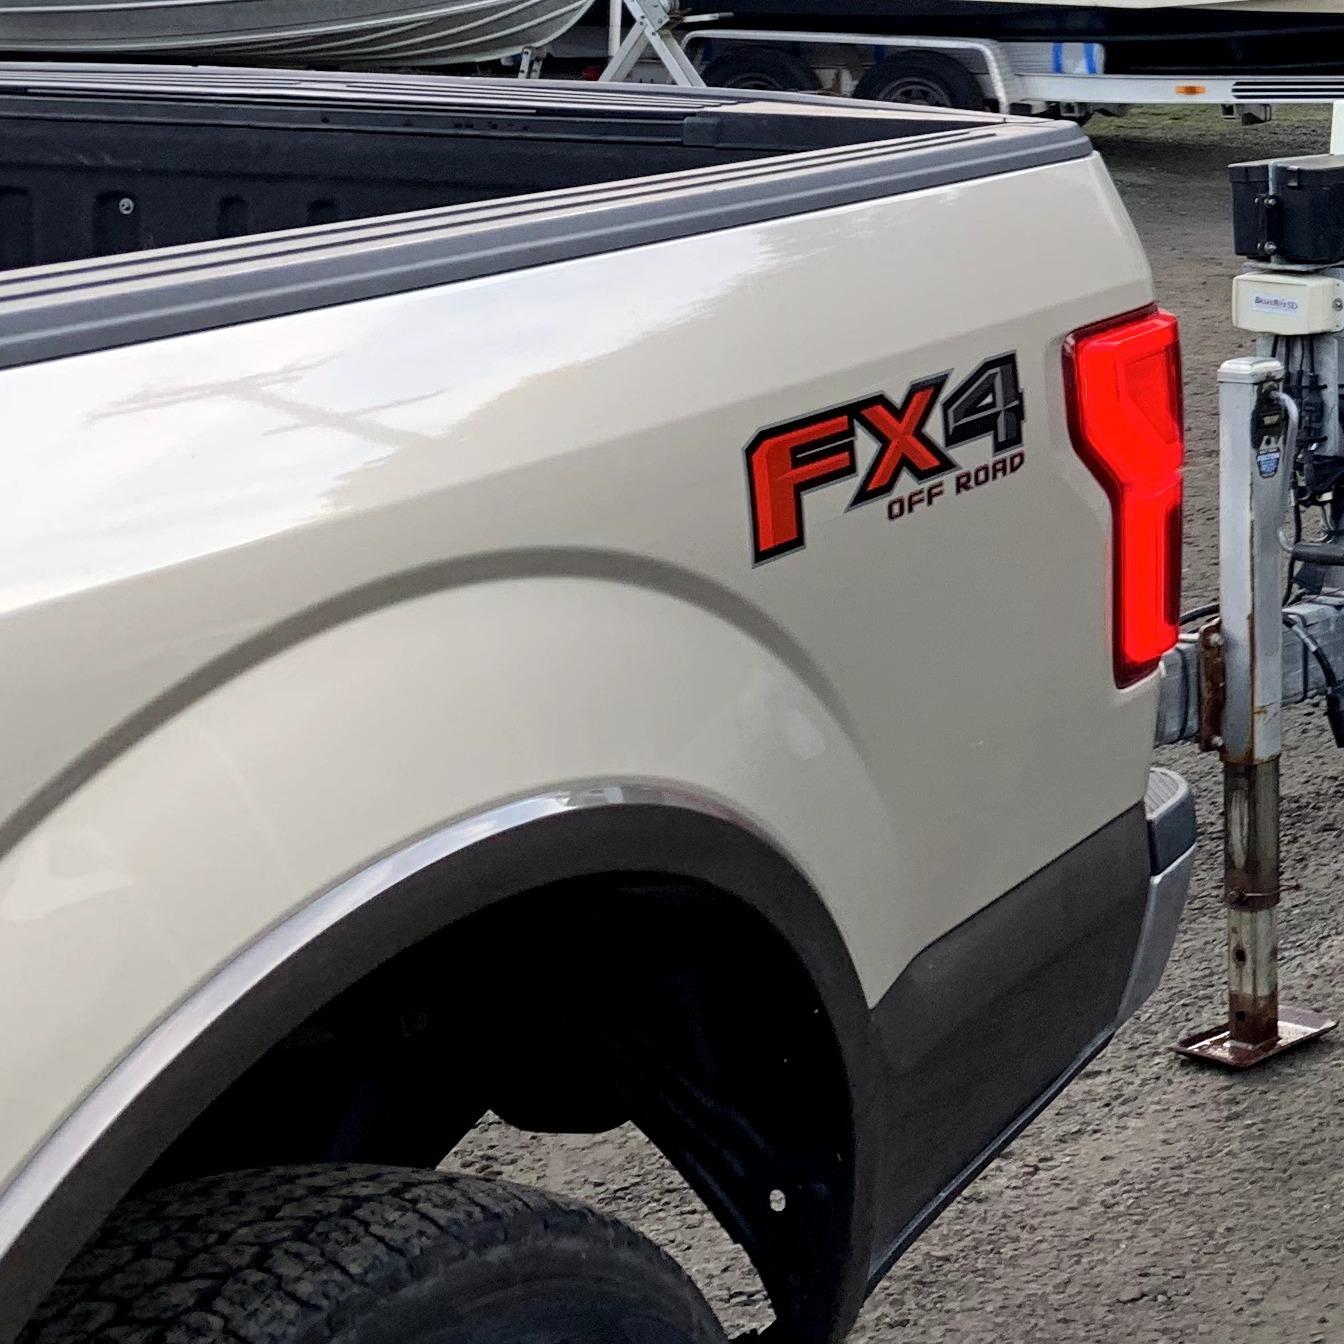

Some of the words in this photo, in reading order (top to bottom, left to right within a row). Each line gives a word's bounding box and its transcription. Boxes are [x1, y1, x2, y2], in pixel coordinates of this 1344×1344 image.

[742, 349, 1025, 569] FX4
[887, 481, 945, 522] OFF
[955, 452, 1025, 496] ROAD
